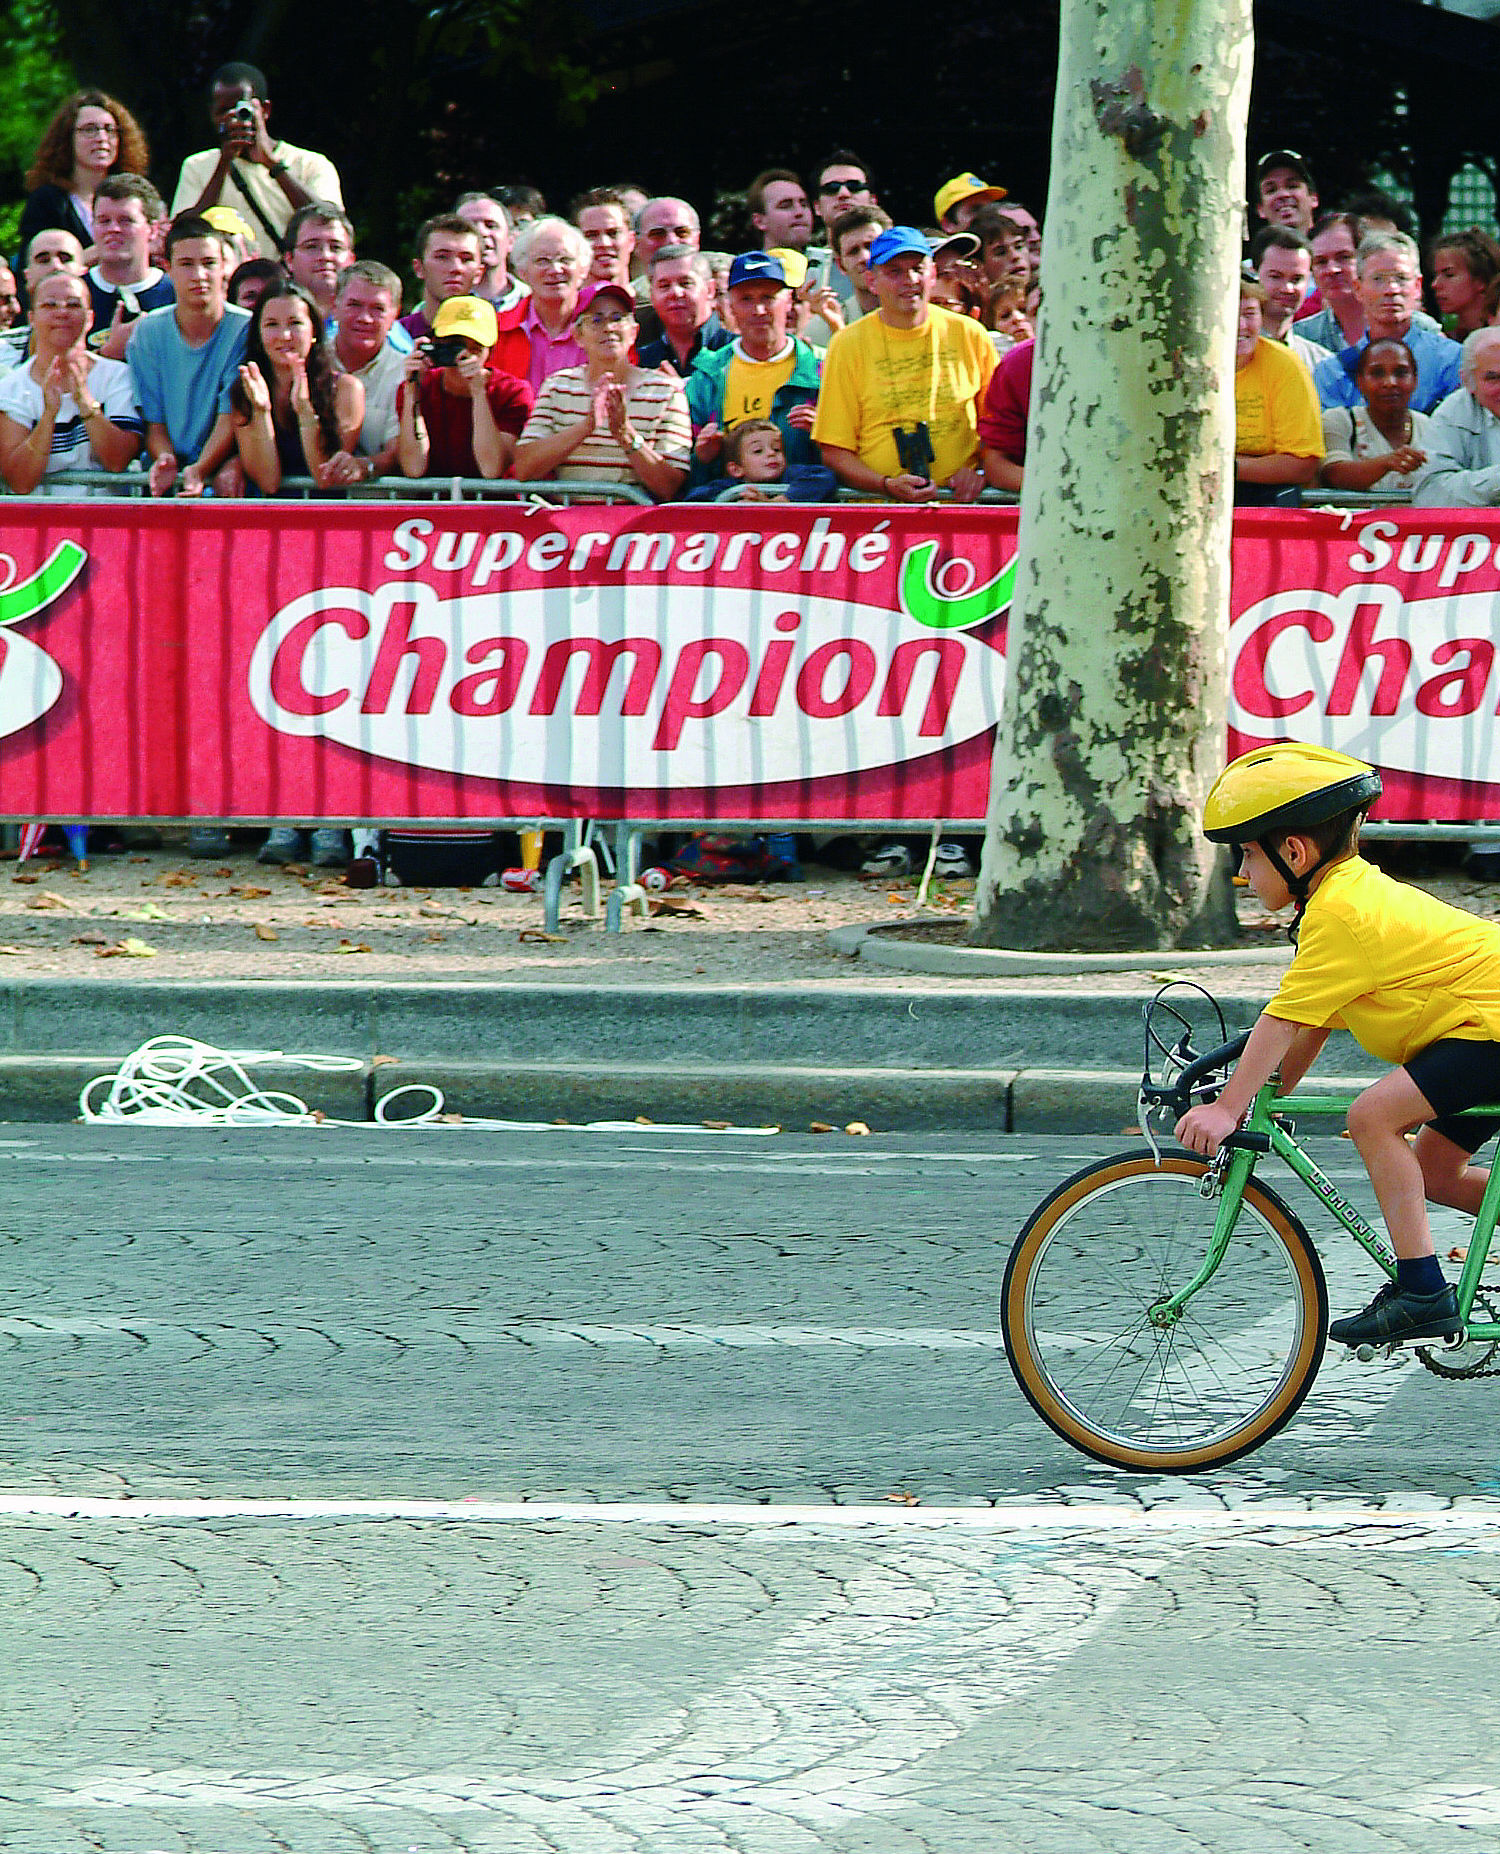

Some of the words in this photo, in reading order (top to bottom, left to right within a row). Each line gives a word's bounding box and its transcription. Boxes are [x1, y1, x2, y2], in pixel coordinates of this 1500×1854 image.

[383, 517, 891, 586] Supermarché
[270, 601, 966, 751] Champion
[1307, 1172, 1397, 1268] LEMONIER
